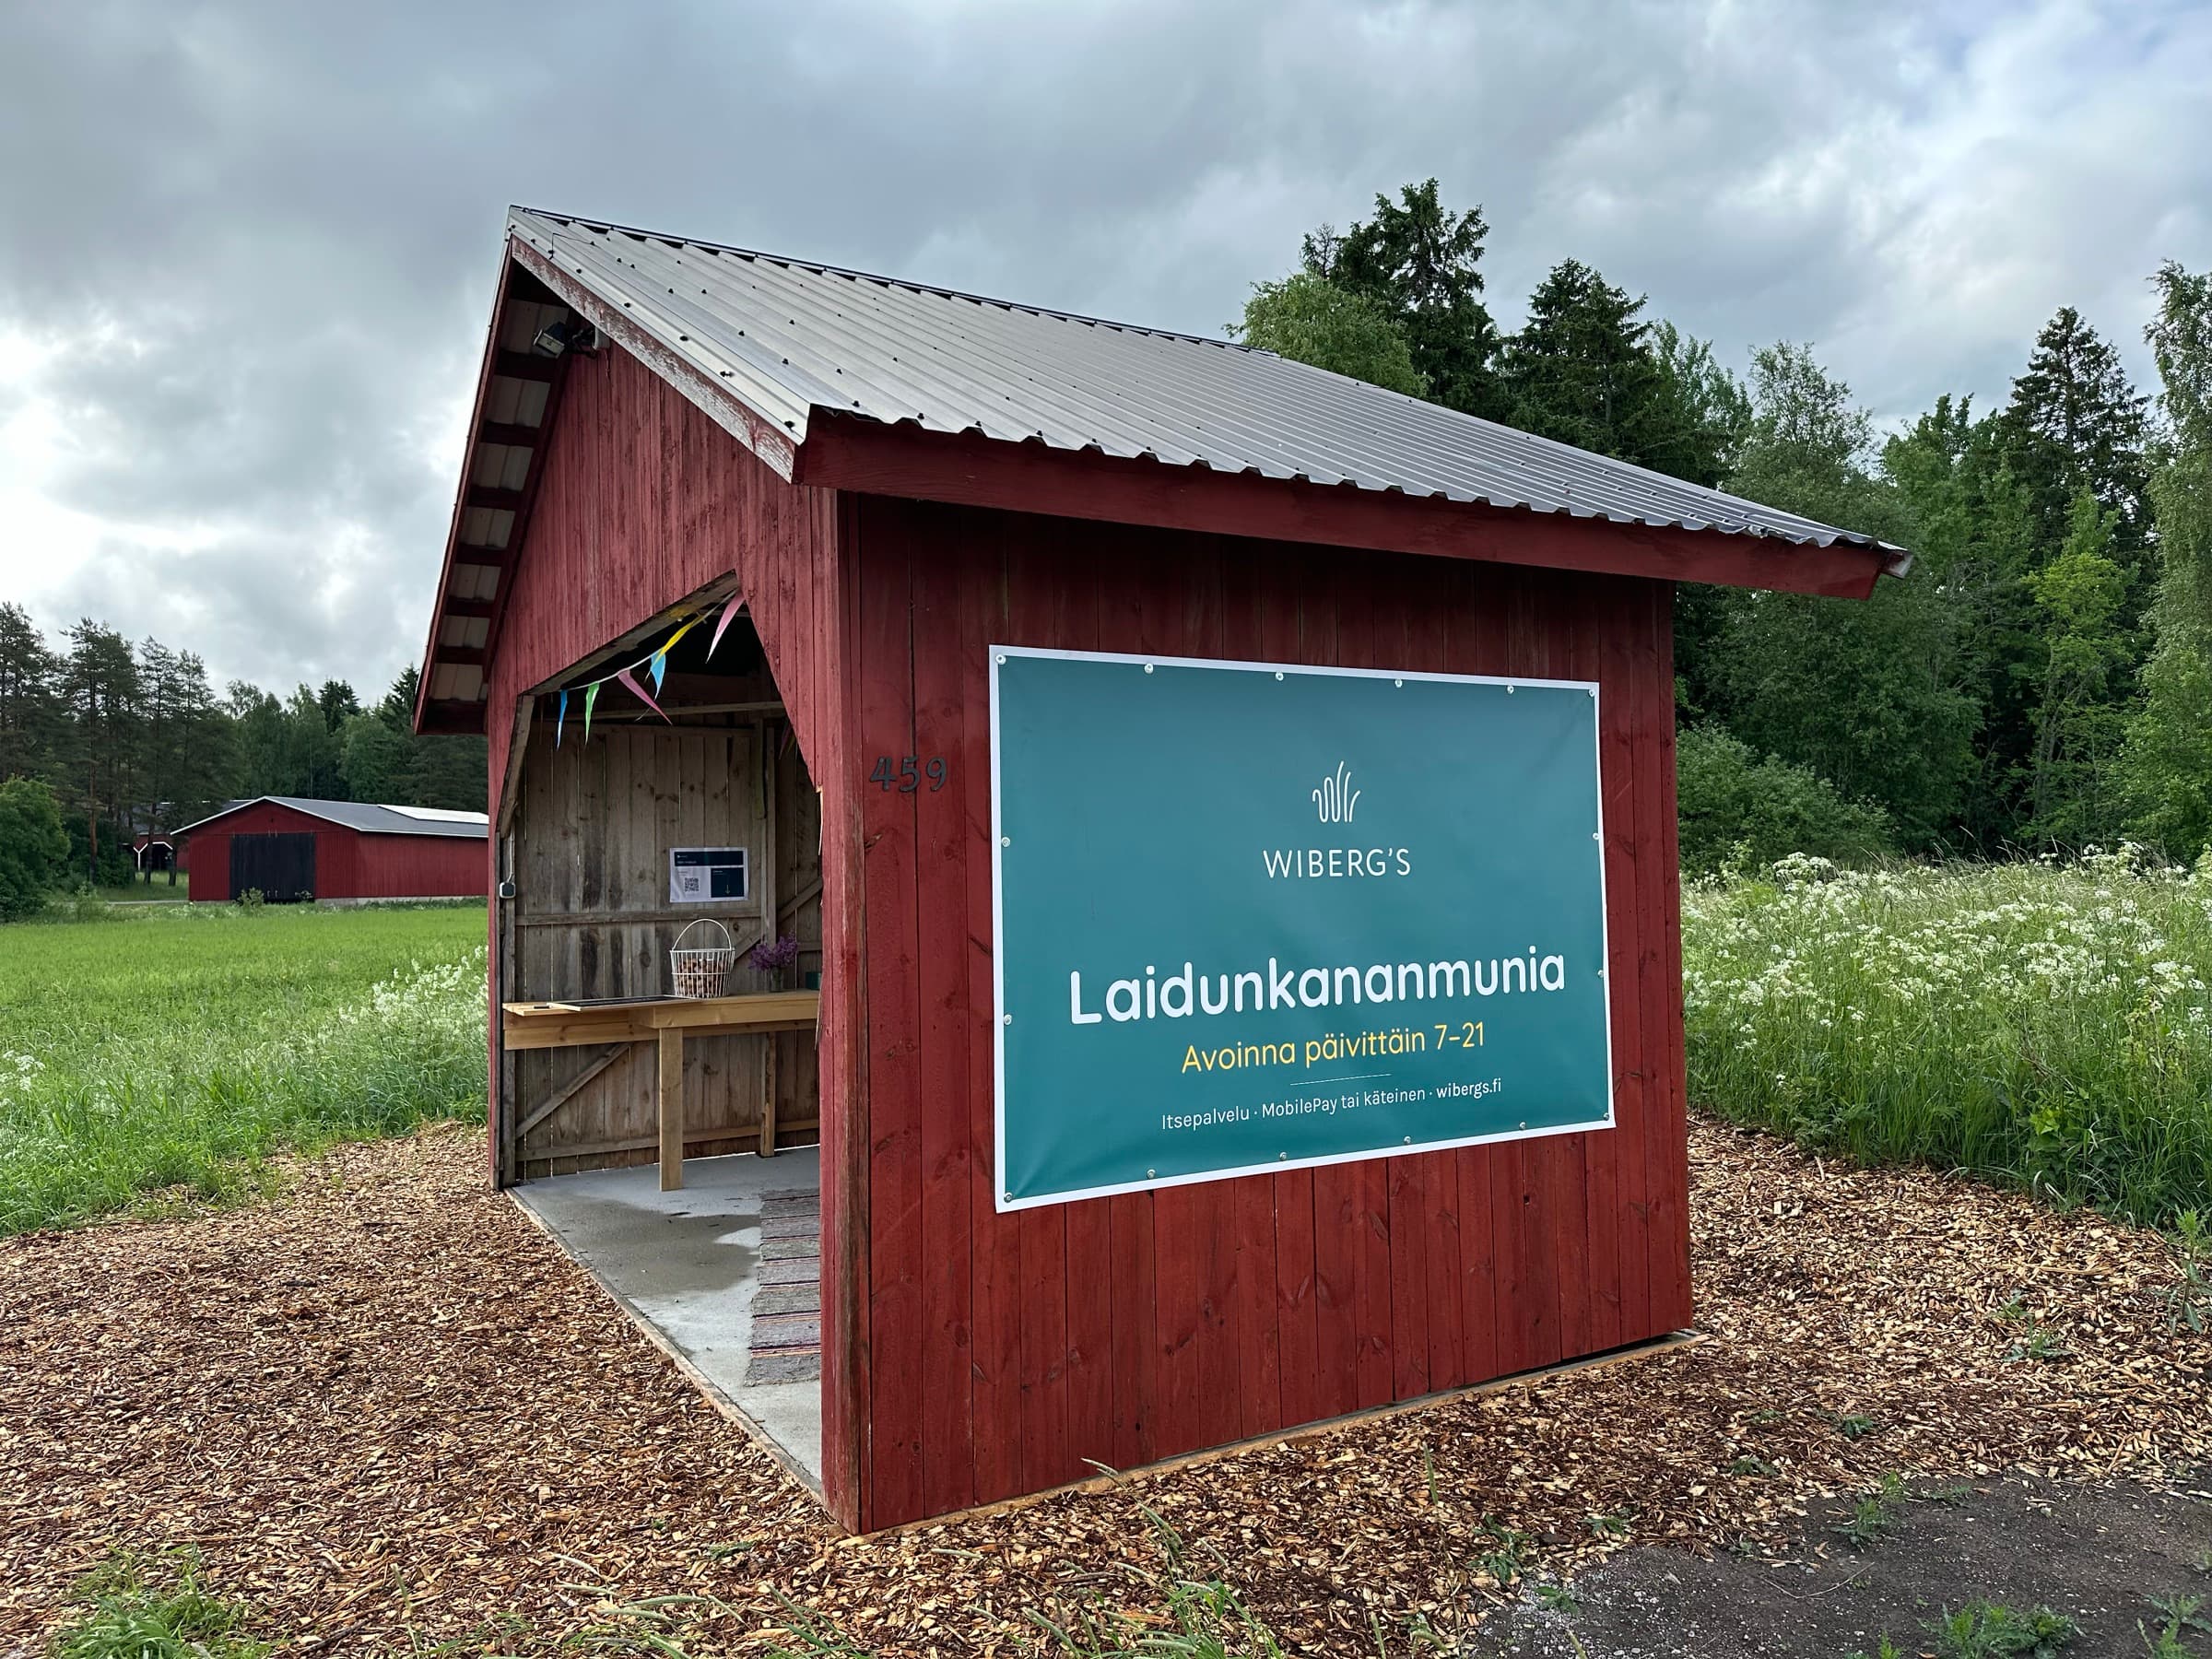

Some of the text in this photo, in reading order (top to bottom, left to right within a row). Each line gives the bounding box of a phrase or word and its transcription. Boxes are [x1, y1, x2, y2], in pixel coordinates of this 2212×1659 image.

[869, 756, 947, 792] 459
[1263, 847, 1412, 878] WIBERG’S
[1070, 945, 1565, 1025] Laidunkananmunia
[1182, 1041, 1296, 1074] Avoinna
[1305, 1028, 1425, 1069] päivittäin
[1162, 1077, 1502, 1131] Itsepalvelu MobilePay tai käteinen wibergs.fi
